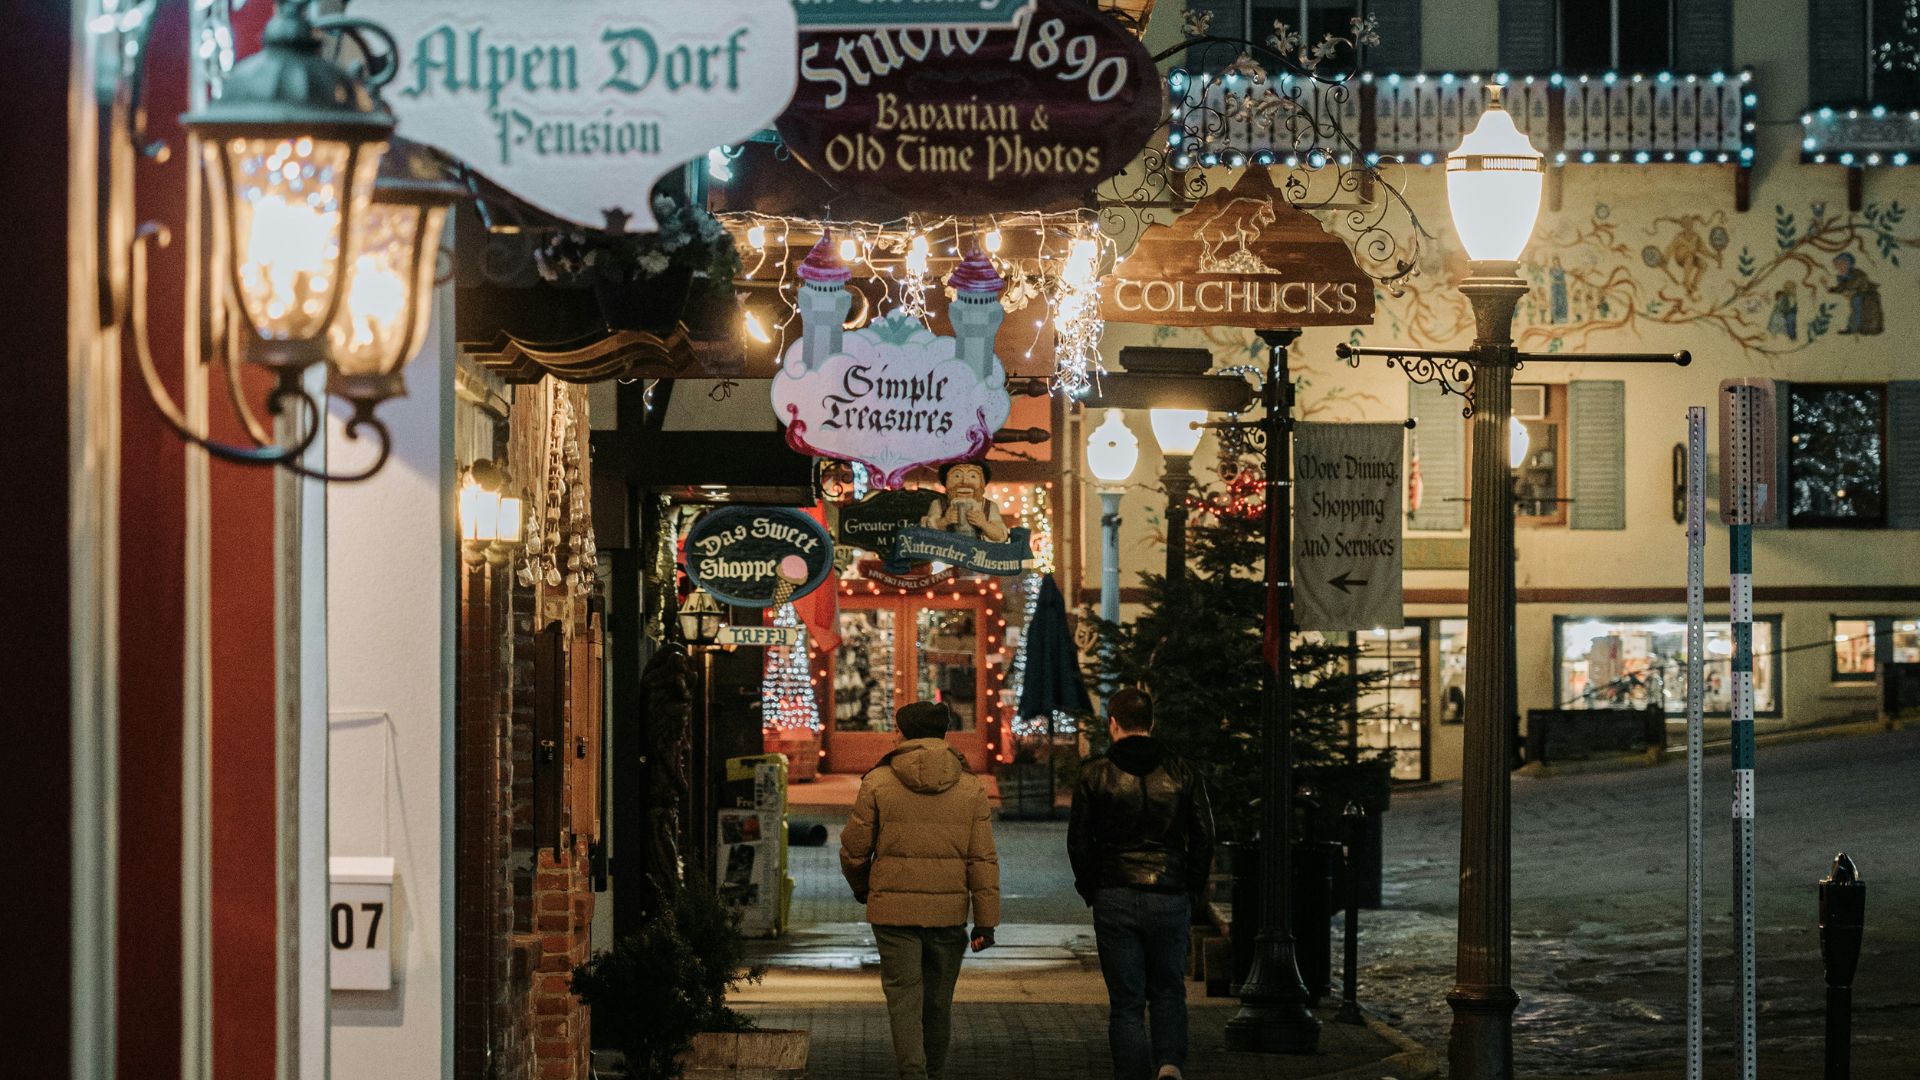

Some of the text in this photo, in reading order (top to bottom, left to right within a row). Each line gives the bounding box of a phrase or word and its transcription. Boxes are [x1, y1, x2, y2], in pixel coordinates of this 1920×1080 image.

[401, 24, 750, 108] Alpen Dorf
[1010, 12, 1128, 101] 1890
[875, 93, 1049, 132] Bavarian &
[492, 108, 661, 165] Pension
[825, 134, 1100, 181] Old Time Photos
[1113, 278, 1358, 314] COLCHUCK'S
[843, 364, 949, 407] Simple
[822, 395, 953, 438] Treasures
[1298, 454, 1341, 480] More
[844, 519, 897, 534] Greater
[1311, 491, 1385, 524] Shopping
[695, 517, 820, 557] Das Sweet
[900, 534, 1020, 572] Nutcracker Museum
[1301, 532, 1395, 557] and Services
[700, 557, 776, 582] Shoppe
[898, 579, 918, 589] HALL
[730, 628, 788, 645] TAFFY
